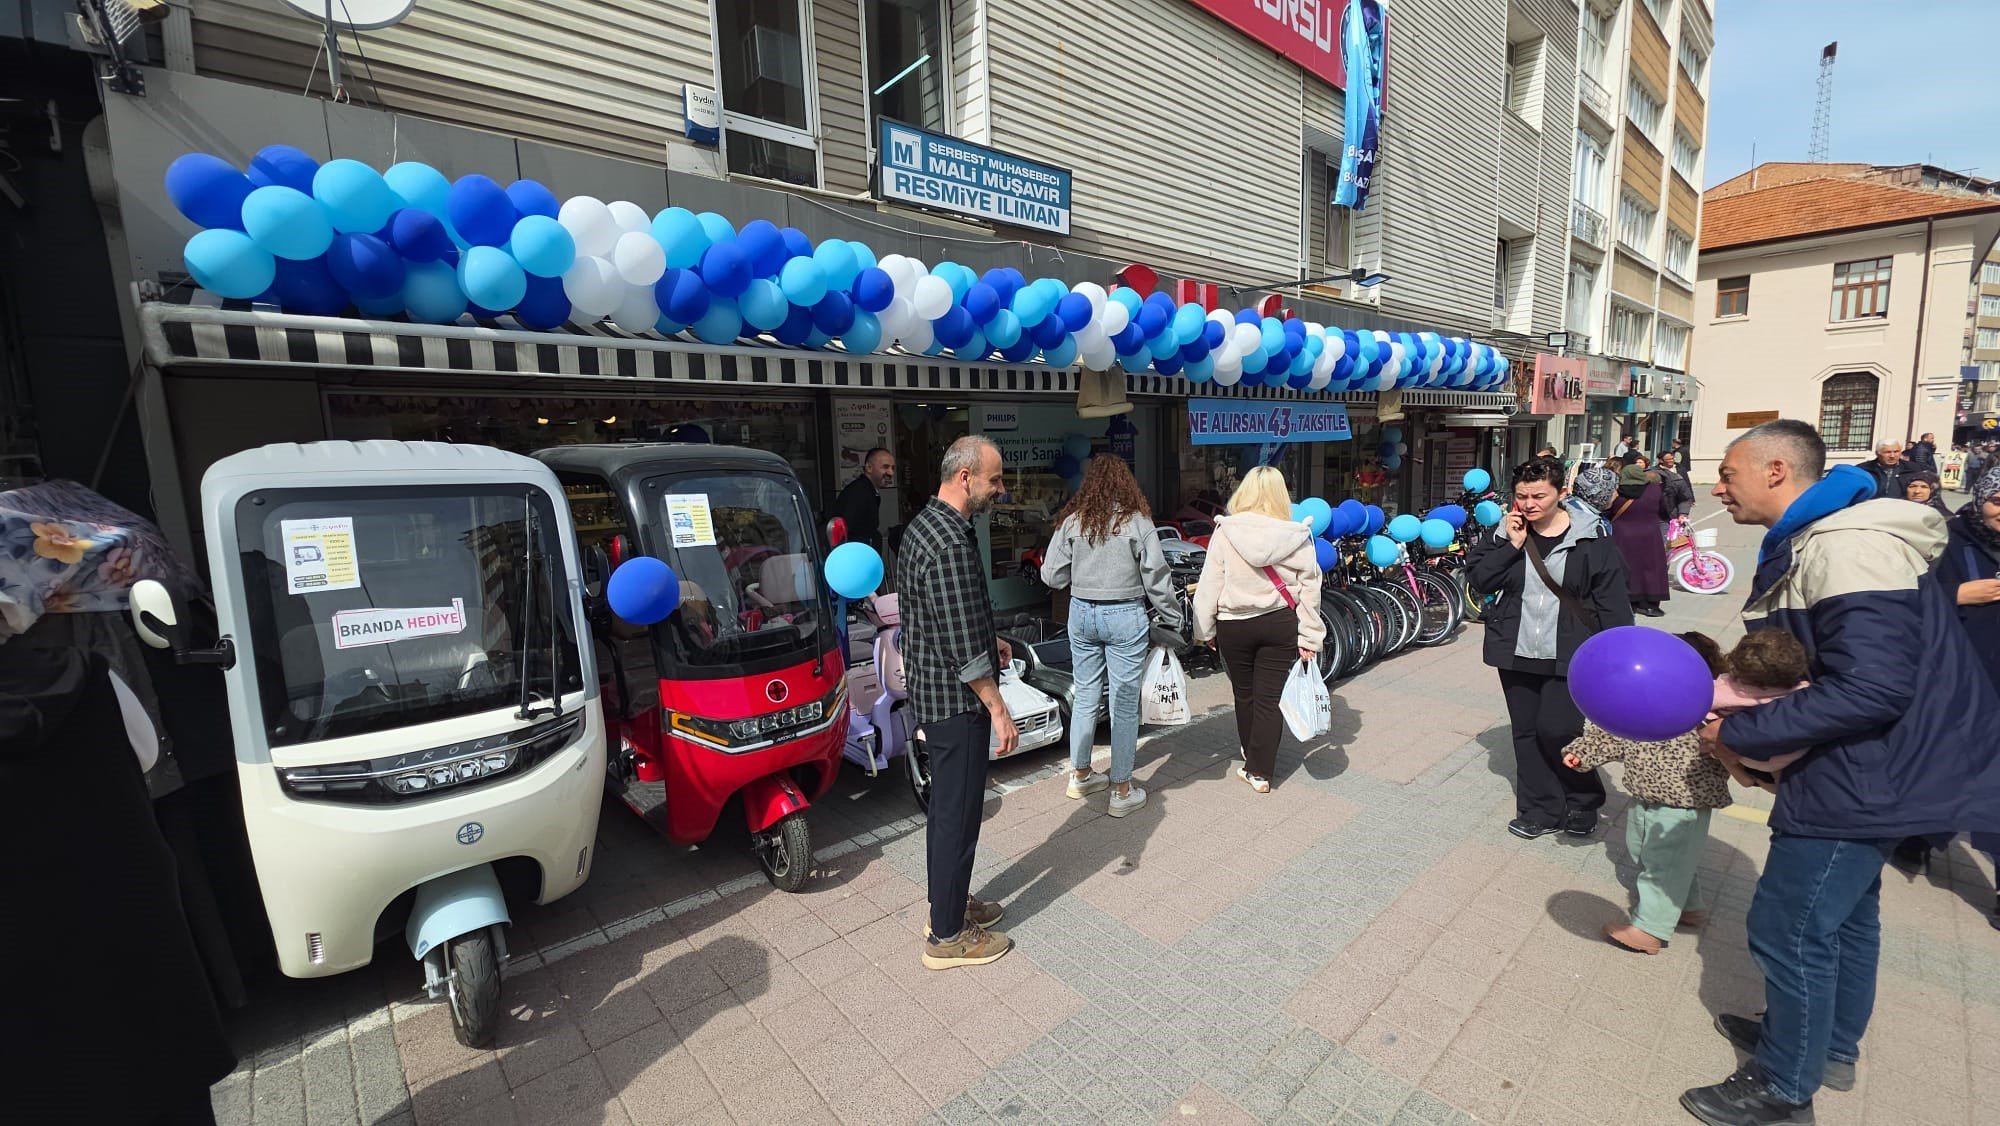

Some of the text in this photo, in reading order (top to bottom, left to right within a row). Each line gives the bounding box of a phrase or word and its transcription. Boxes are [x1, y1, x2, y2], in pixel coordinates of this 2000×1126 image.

[928, 142, 986, 166] SERBEST
[997, 193, 1060, 227] ILIMAN
[986, 414, 1016, 423] PHILIPS
[1189, 411, 1208, 433] NE
[1210, 411, 1266, 433] ALIRSAN
[1267, 406, 1292, 438] 43
[1298, 408, 1347, 432] TAKSİTLE
[340, 612, 459, 637] BRANDA HEDİYE
[394, 735, 509, 766] AROKA
